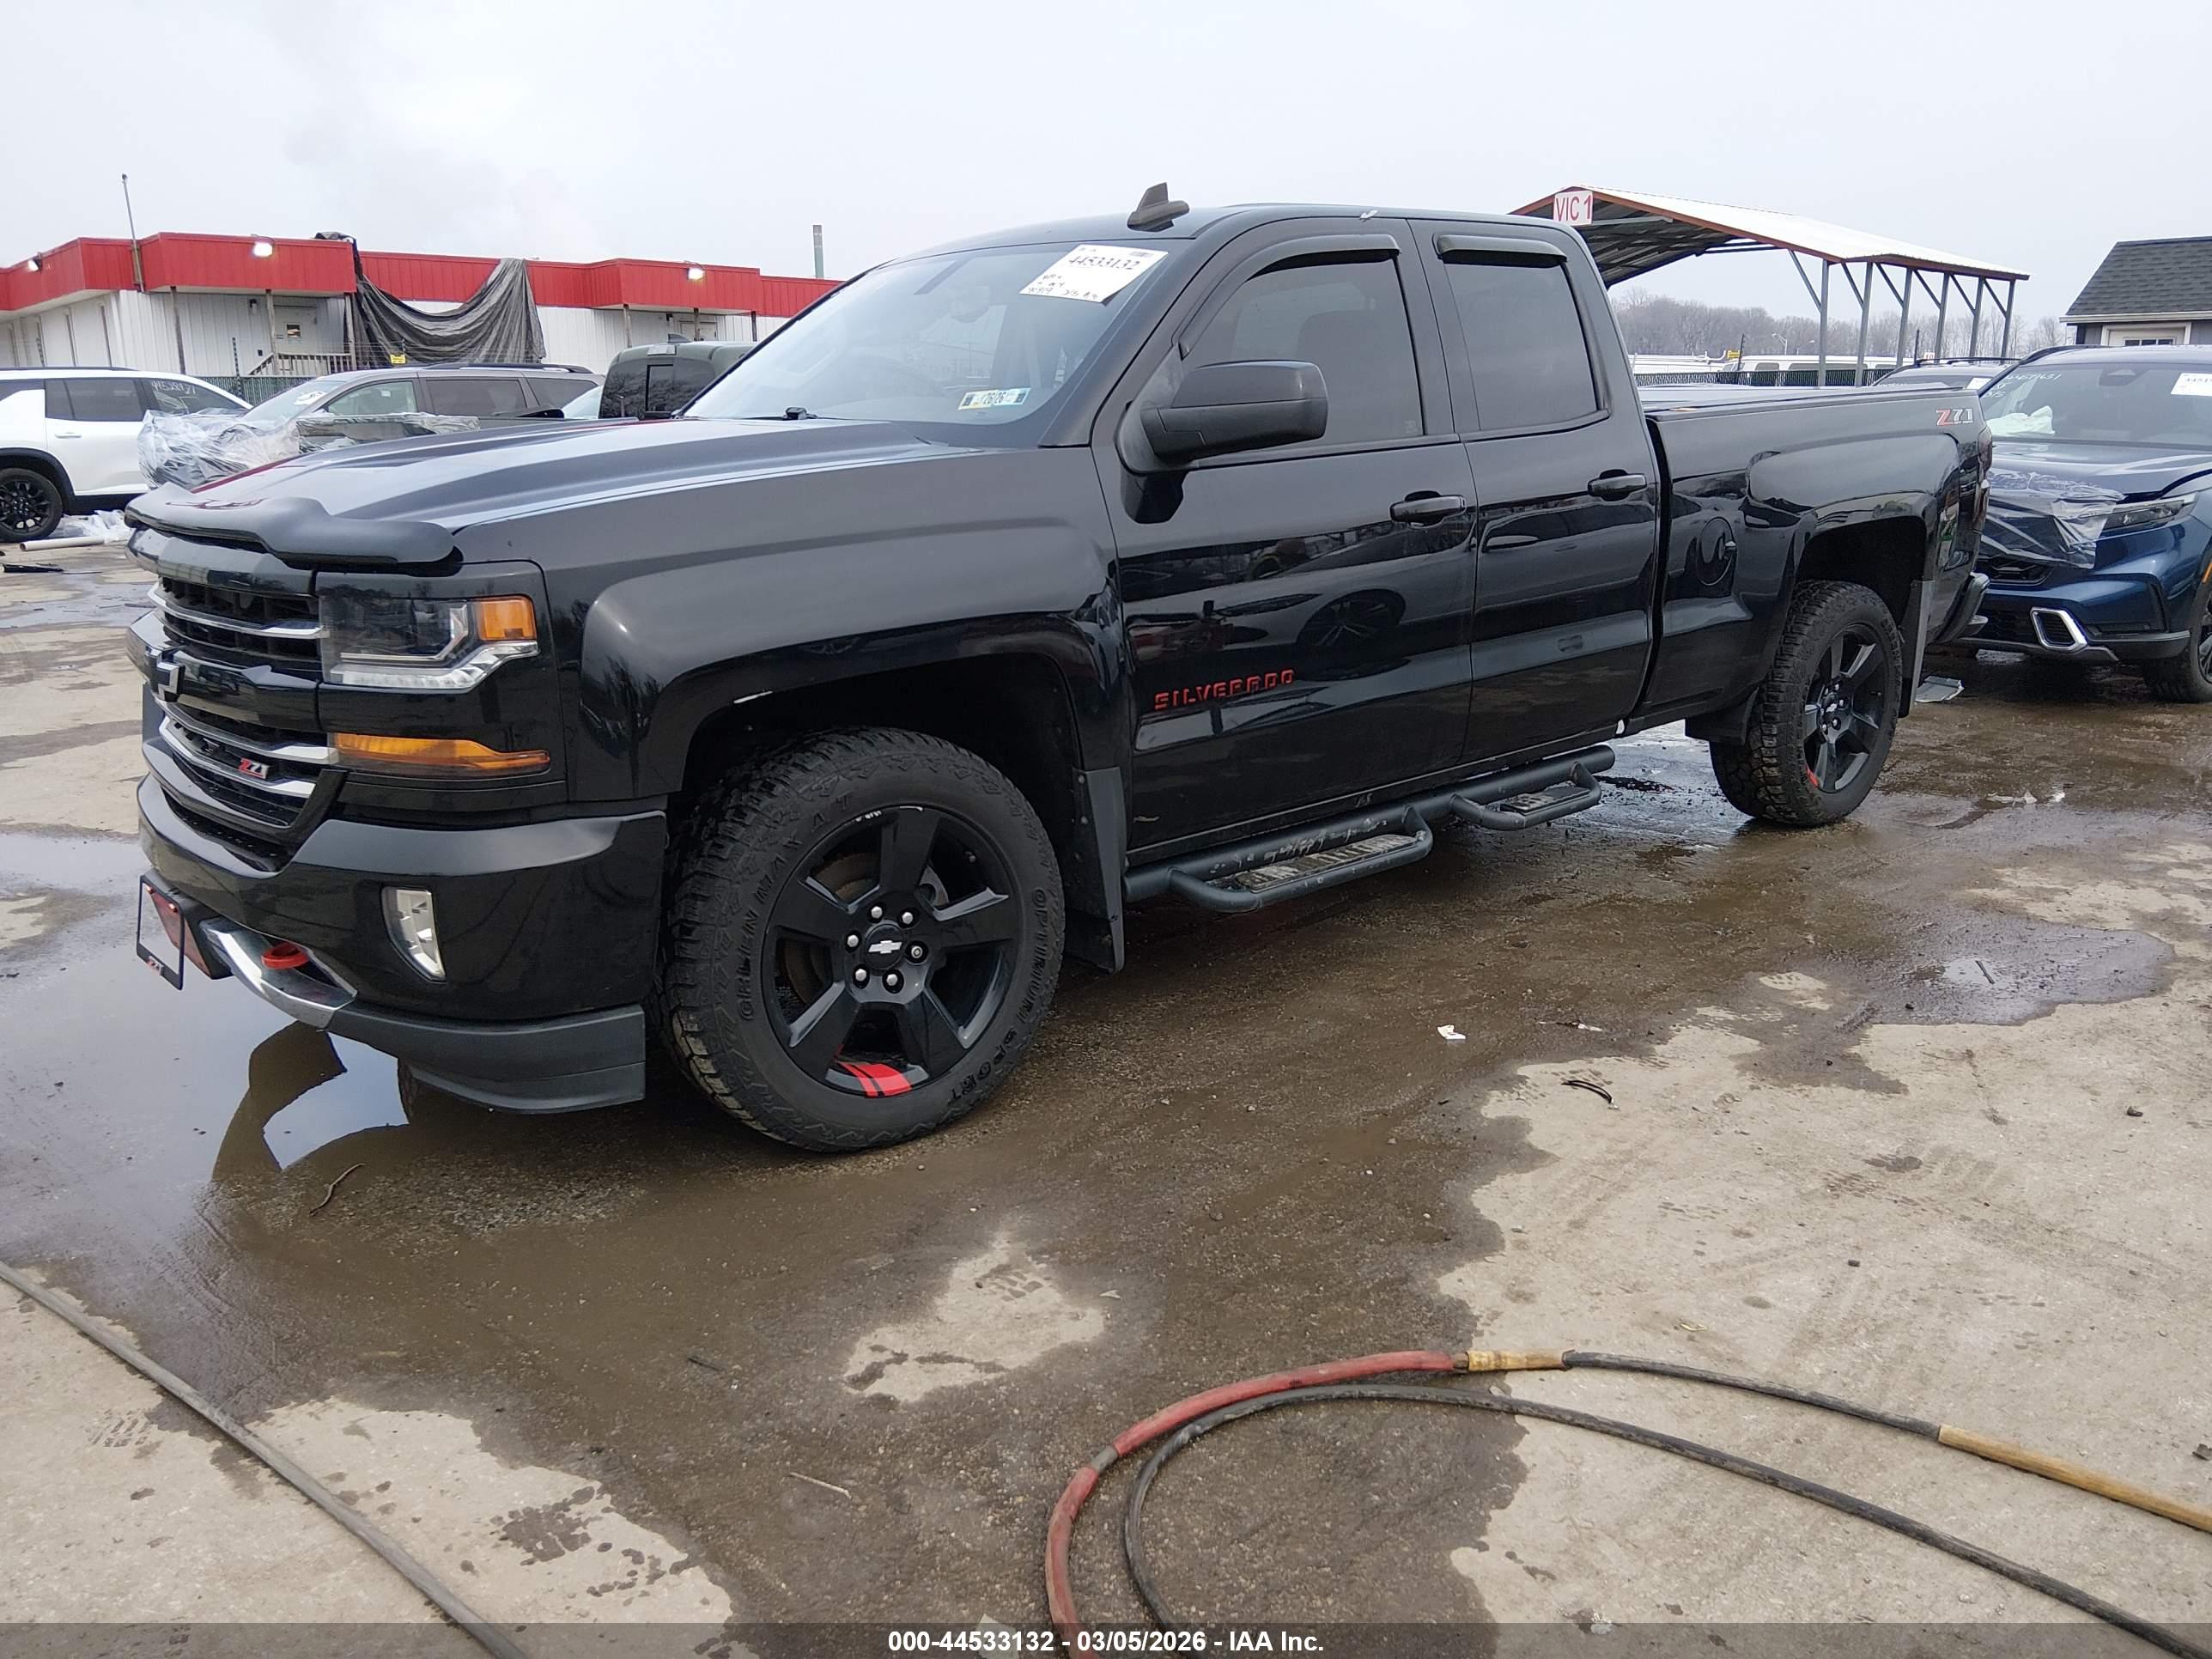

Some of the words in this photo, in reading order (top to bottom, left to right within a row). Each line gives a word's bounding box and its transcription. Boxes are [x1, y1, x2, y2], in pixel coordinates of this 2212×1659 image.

[1555, 196, 1580, 222] VIC
[1583, 194, 1592, 220] 1
[1068, 255, 1141, 270] 44533132
[1936, 408, 1973, 426] Z71
[1153, 669, 1295, 710] SILVERADO
[238, 757, 270, 780] Z71
[948, 1027, 1018, 1106] SPORT
